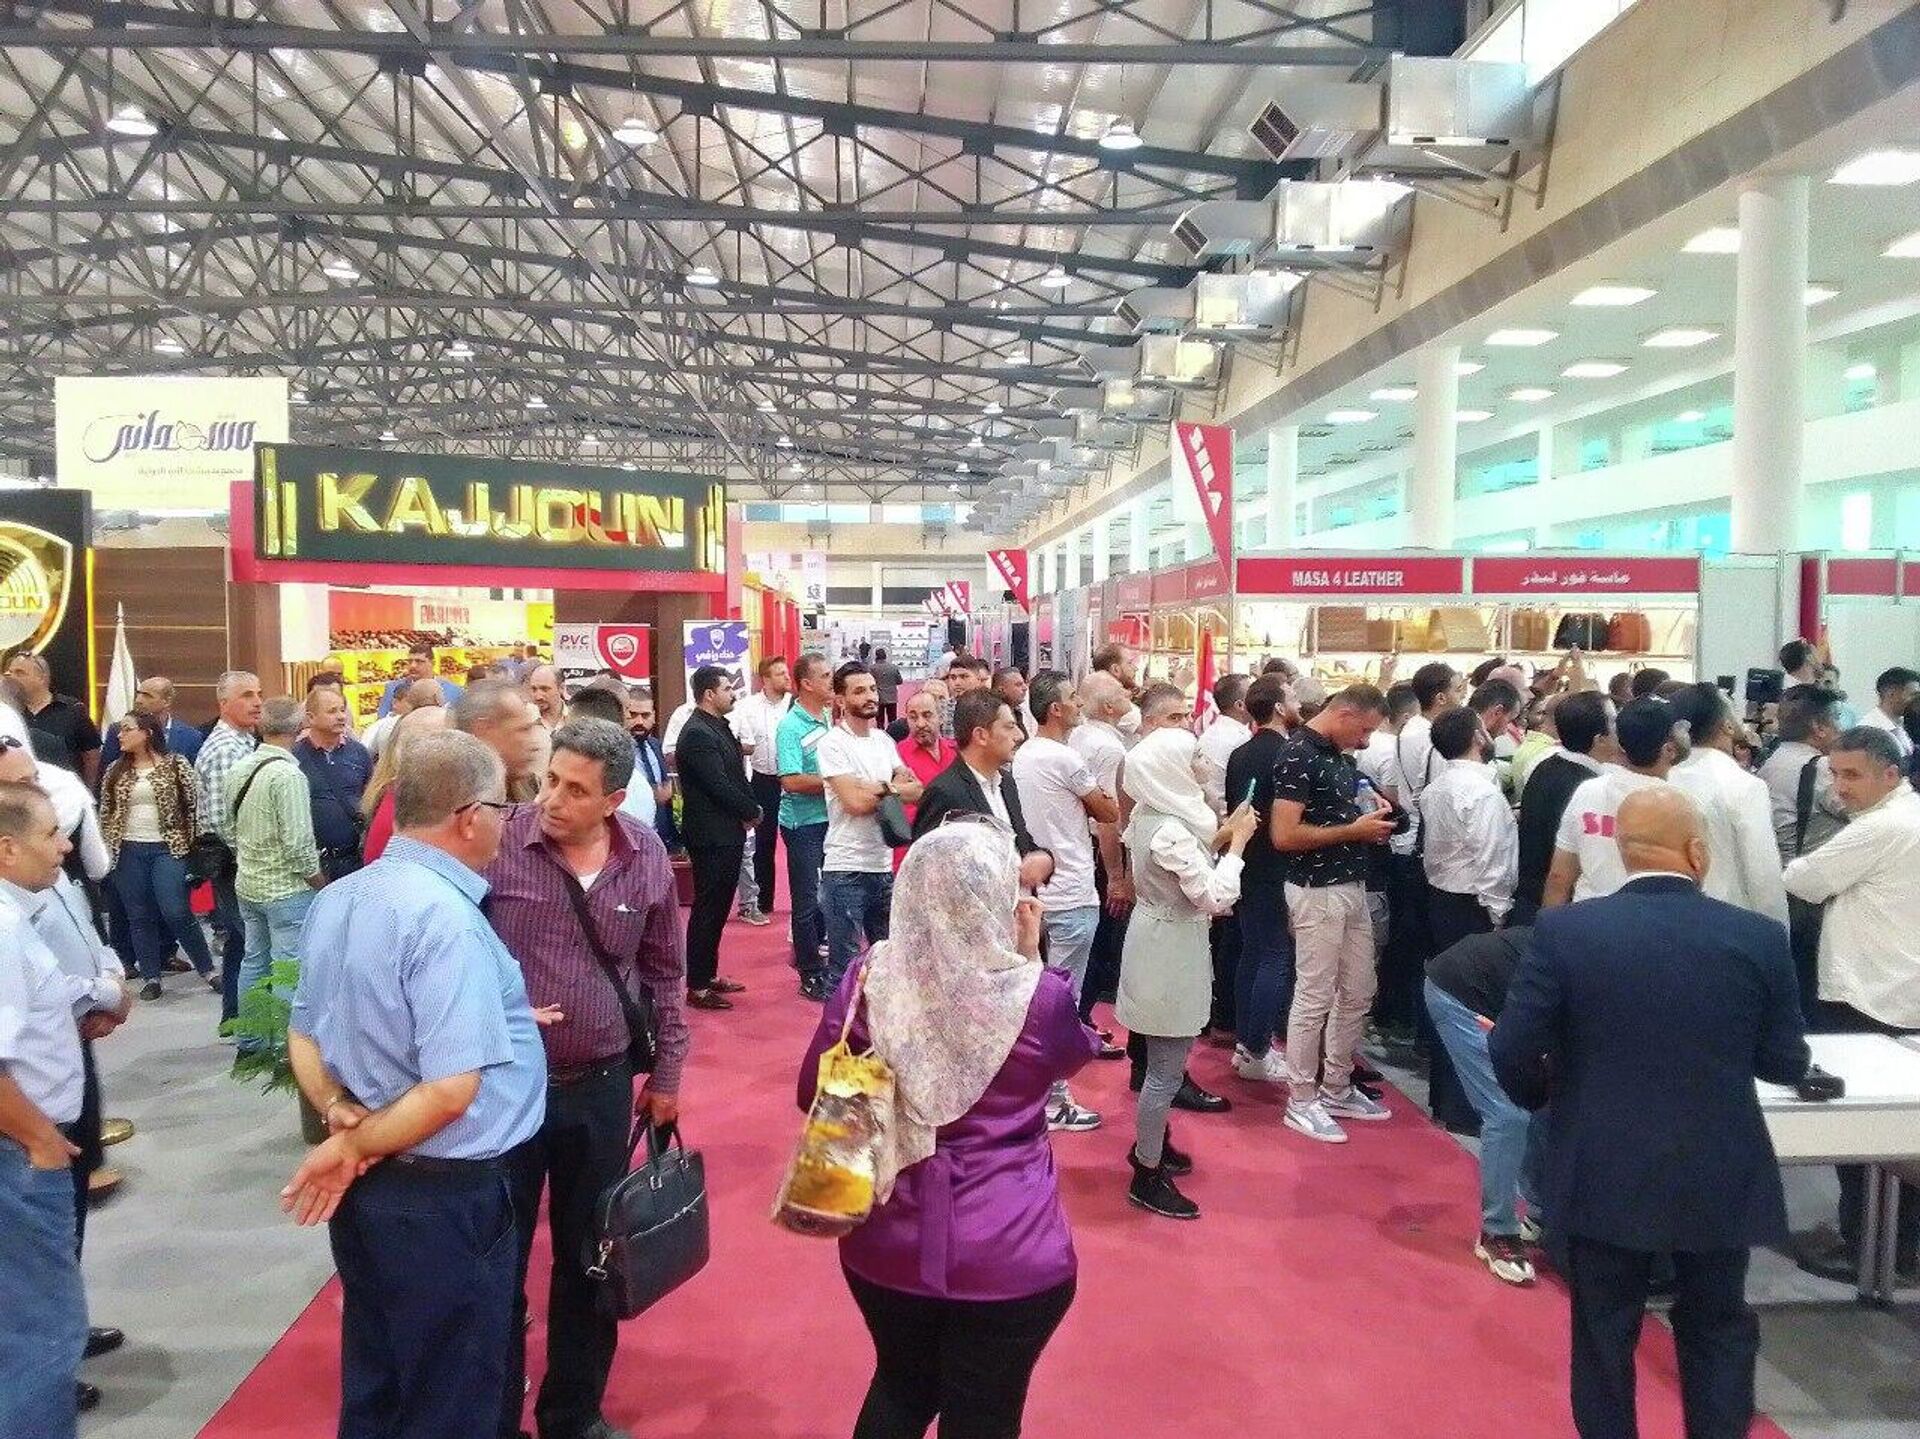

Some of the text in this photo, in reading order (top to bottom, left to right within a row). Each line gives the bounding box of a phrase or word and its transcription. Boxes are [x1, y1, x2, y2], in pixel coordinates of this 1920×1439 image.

[317, 471, 685, 548] KAJJOUN
[1292, 570, 1404, 586] MASA 4 LEATHER
[560, 634, 590, 645] PVC
